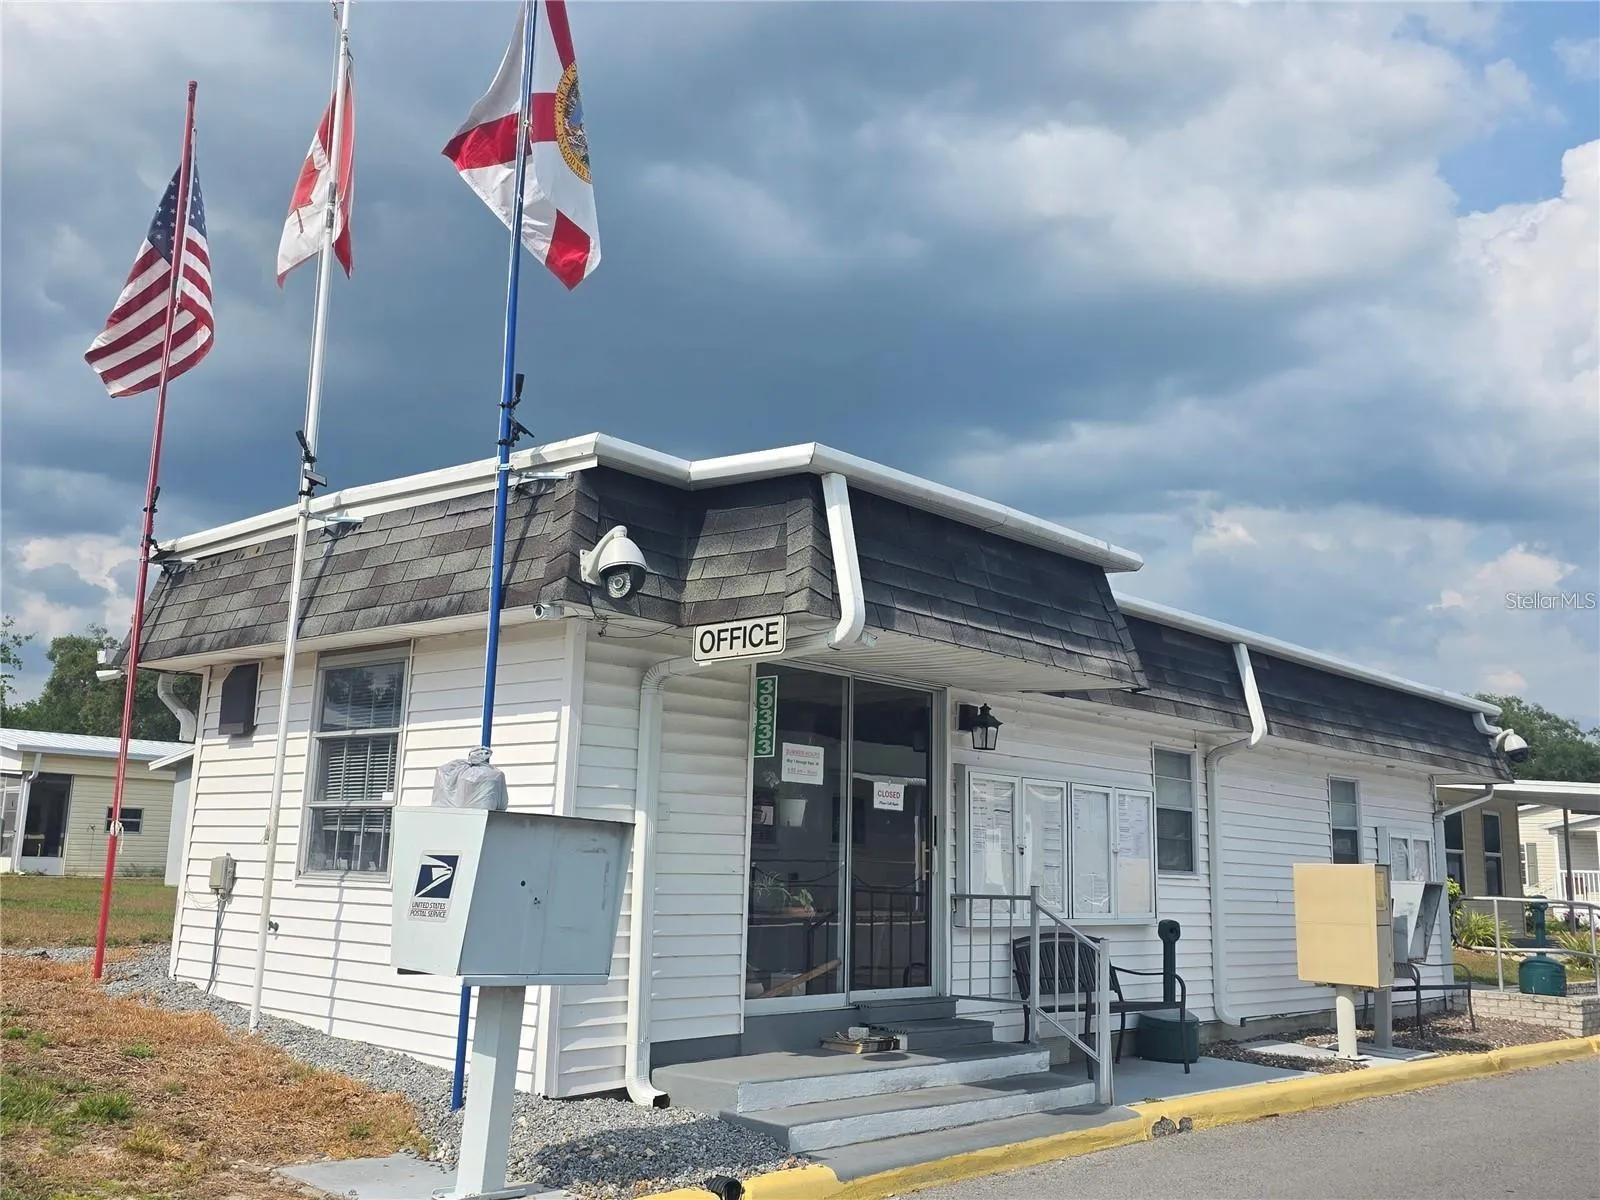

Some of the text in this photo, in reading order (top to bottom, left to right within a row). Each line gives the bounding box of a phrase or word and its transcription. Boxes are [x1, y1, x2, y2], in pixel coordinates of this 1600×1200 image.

[563, 146, 576, 165] GOD
[700, 622, 779, 653] OFFICE
[757, 679, 773, 754] 39333
[878, 791, 900, 799] CLOSED
